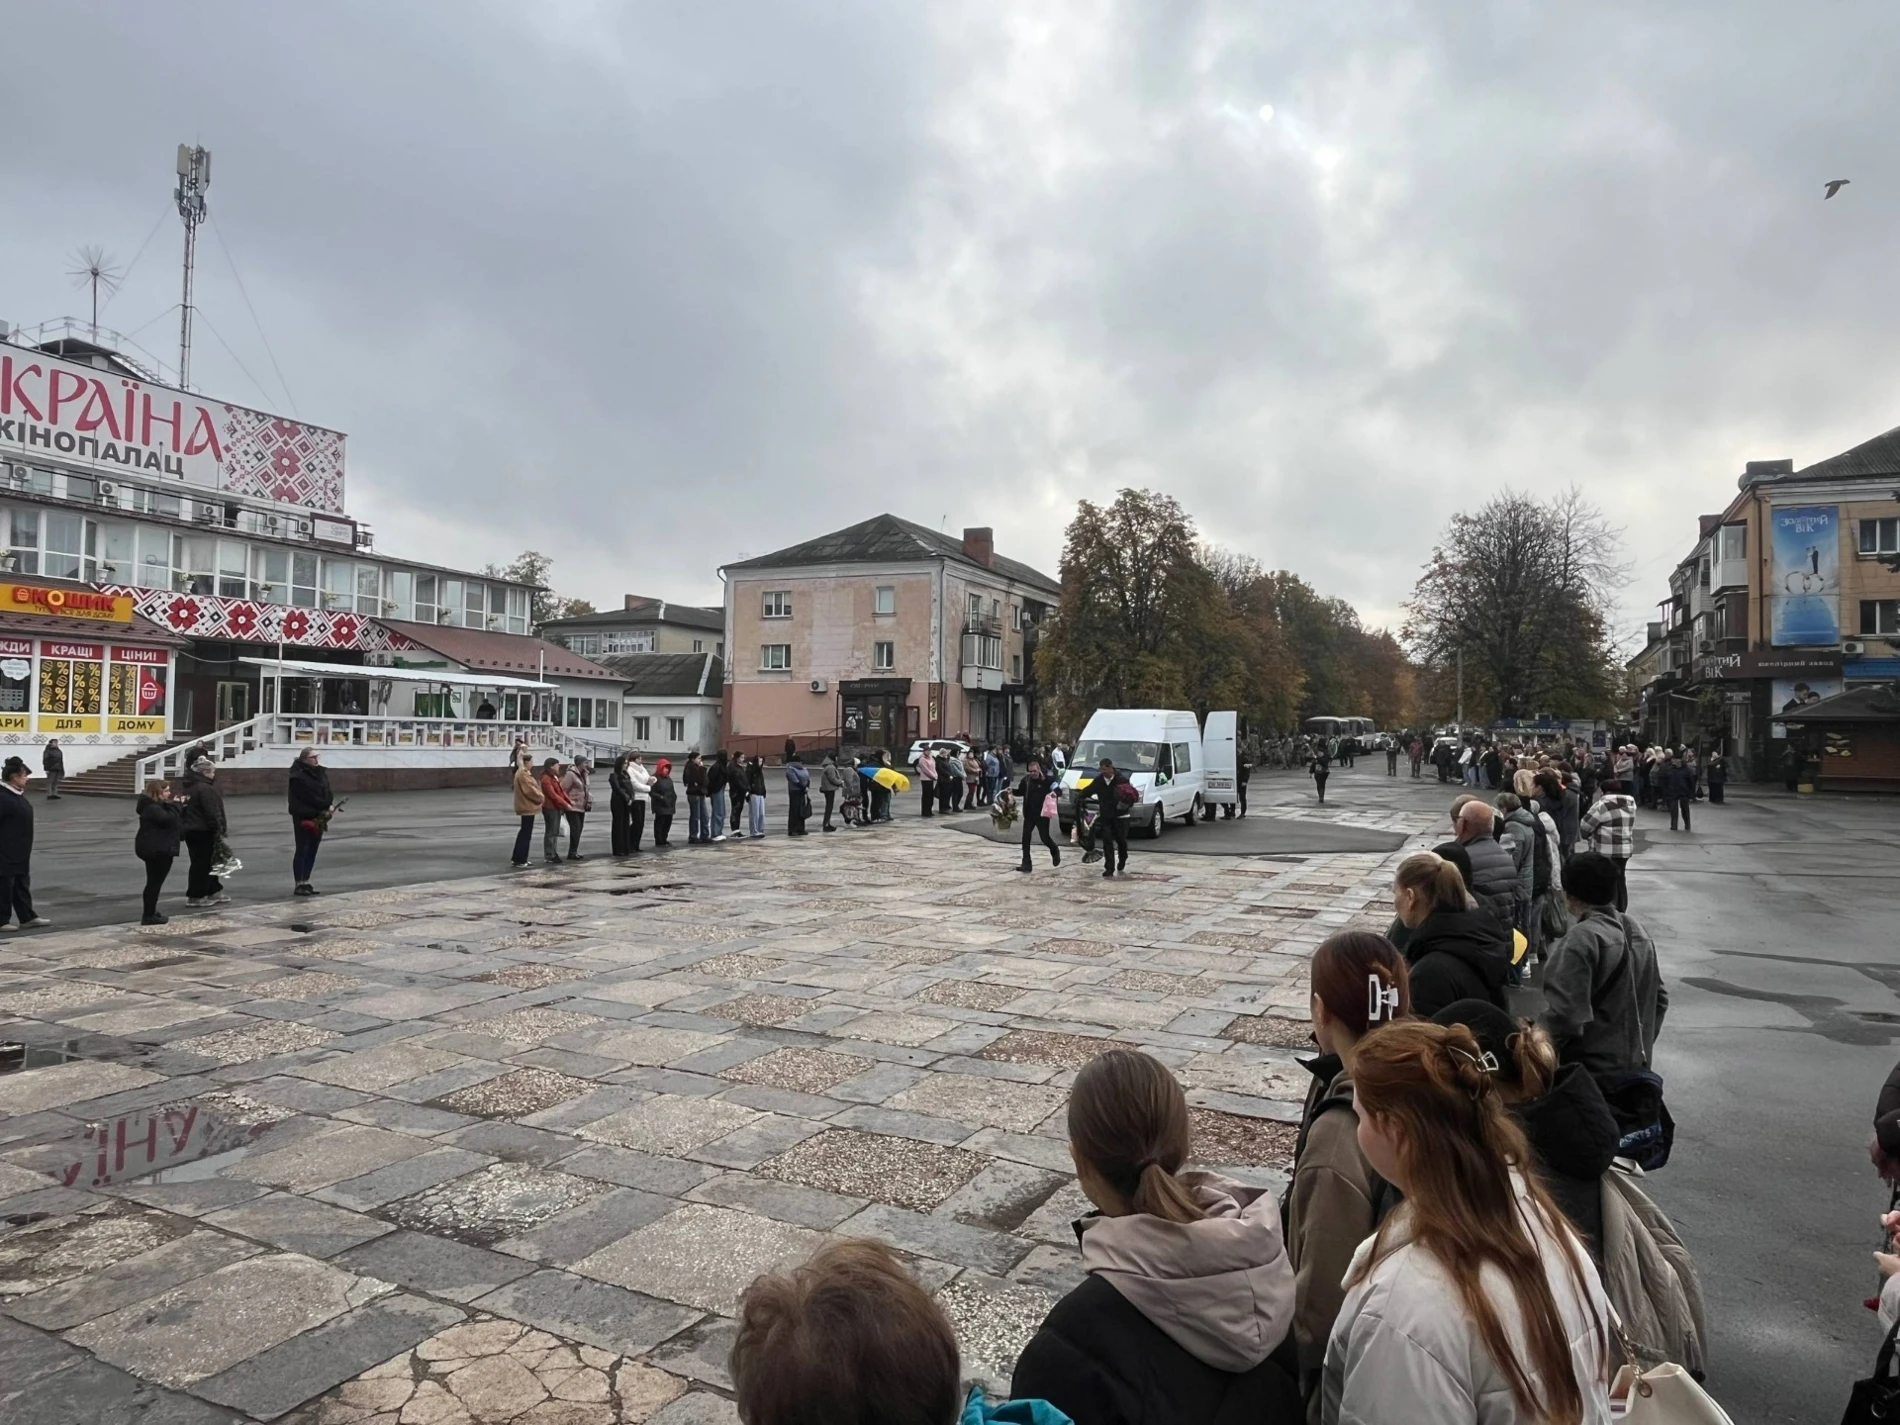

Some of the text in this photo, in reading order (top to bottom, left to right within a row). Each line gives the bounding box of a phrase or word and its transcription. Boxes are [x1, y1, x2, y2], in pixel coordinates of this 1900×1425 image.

[0, 416, 185, 480] КІНОПАЛАЦ
[32, 589, 115, 614] КОШИК
[51, 644, 93, 658] КРАЩІ
[1705, 665, 1724, 679] ВІК
[55, 719, 82, 730] ДЛЯ
[117, 720, 156, 731] ДОМУ
